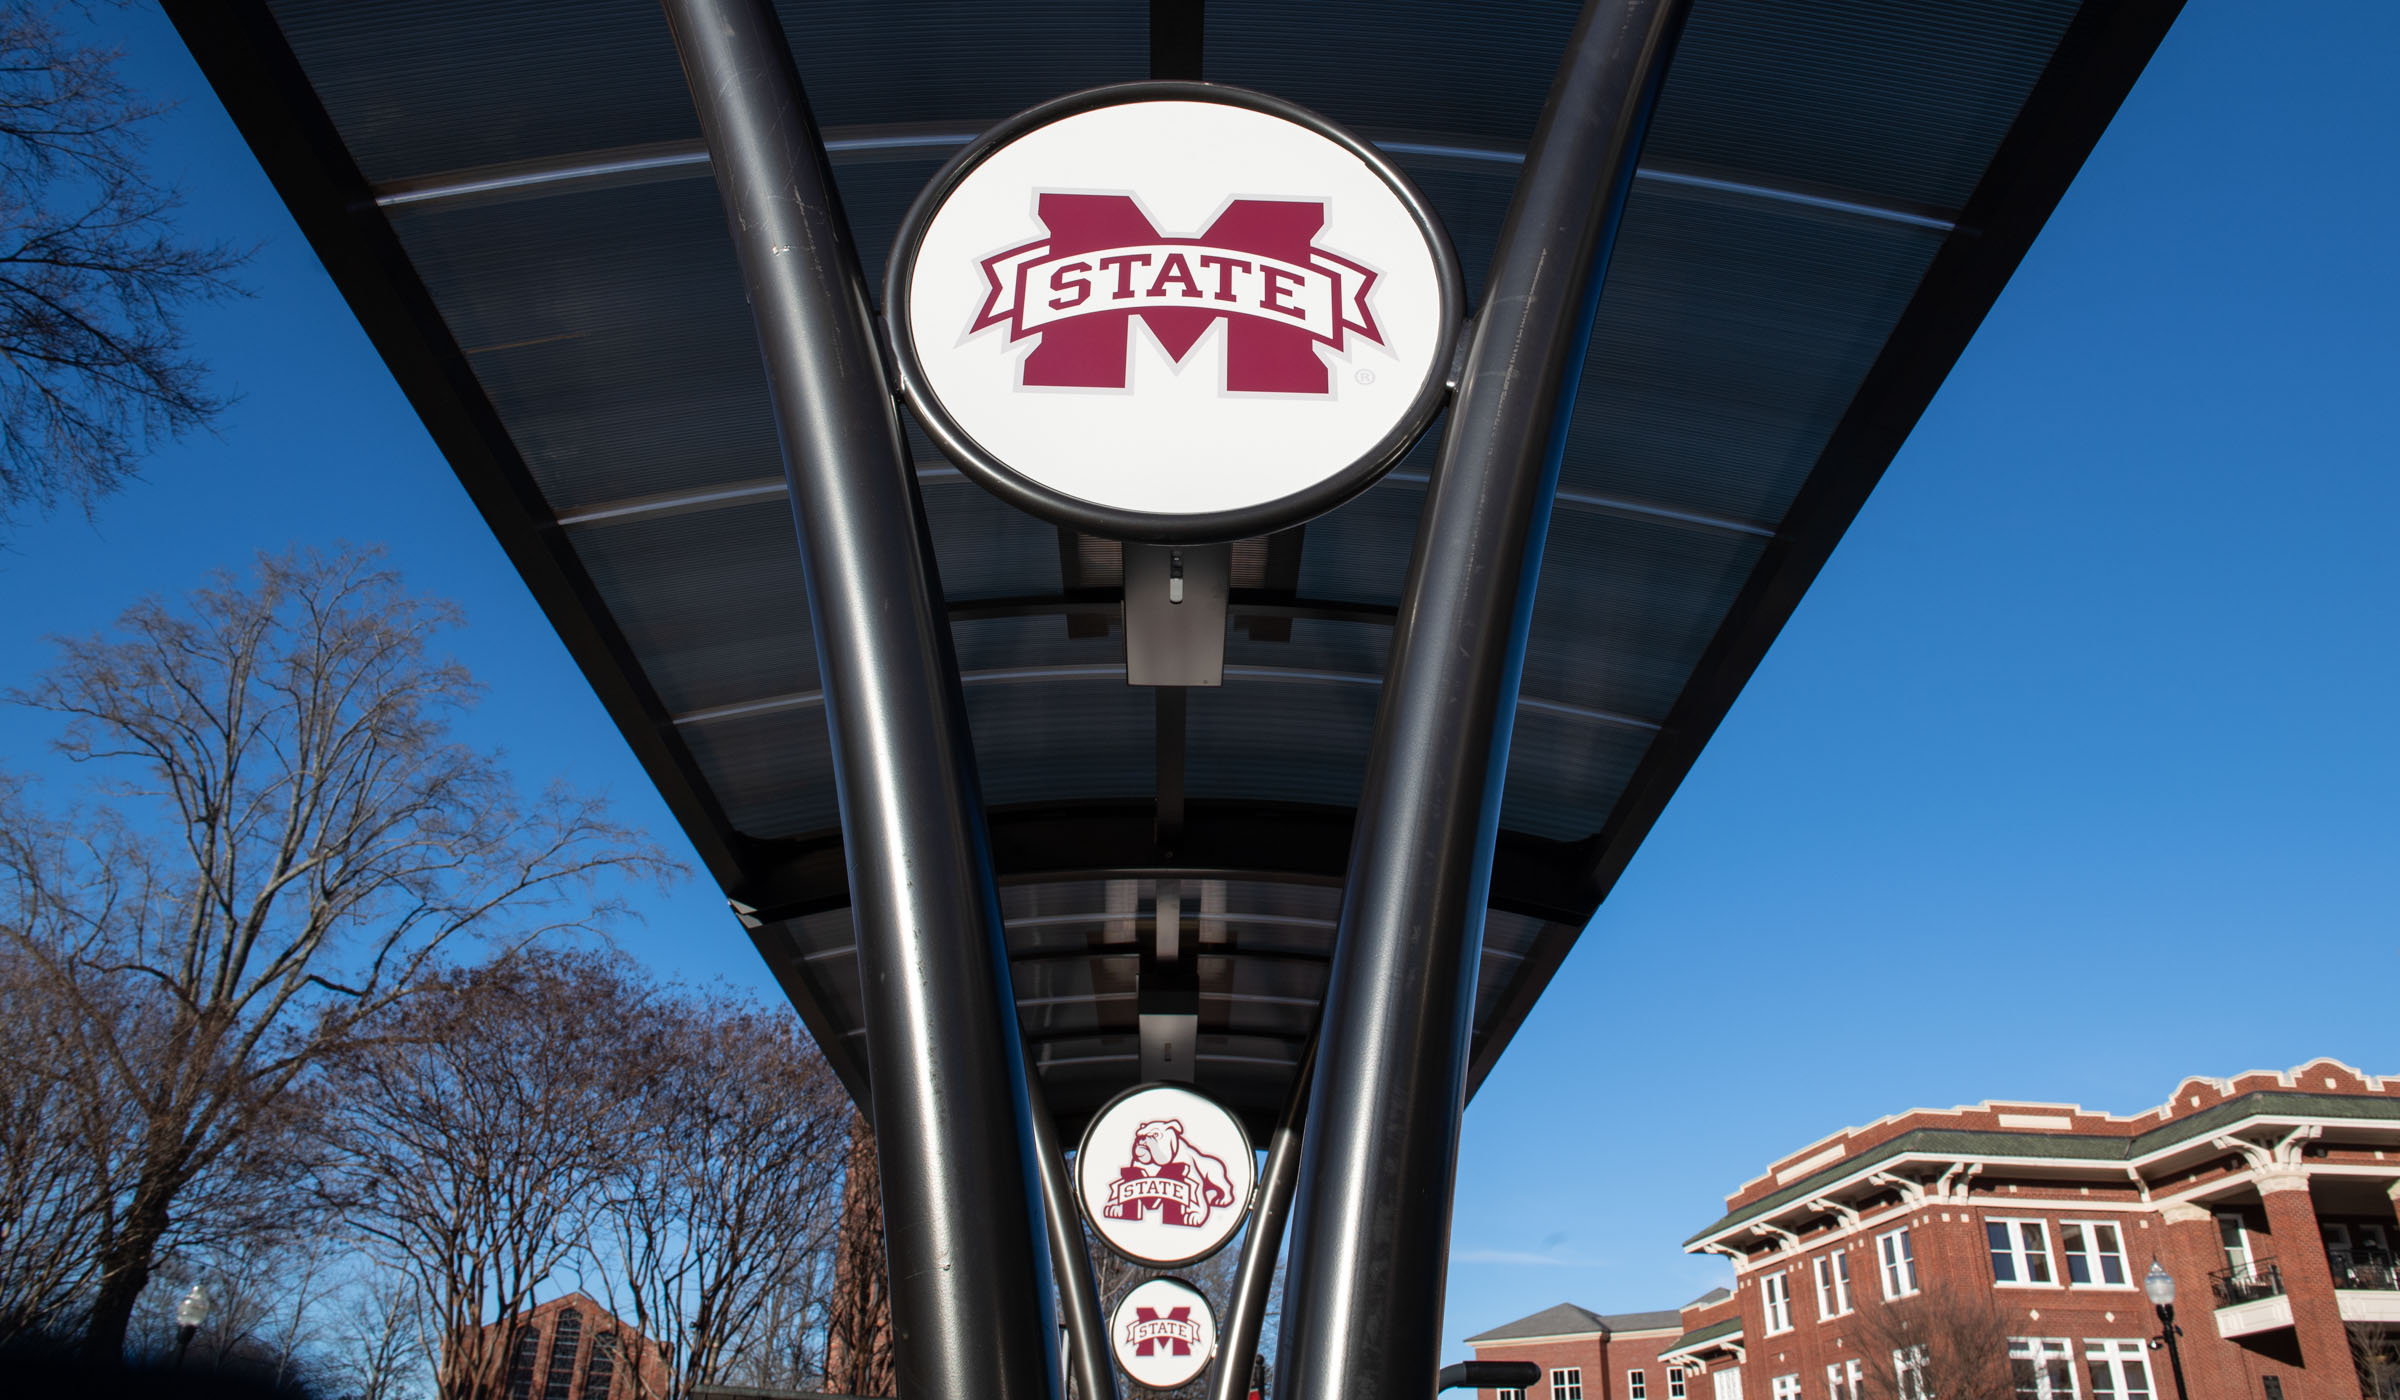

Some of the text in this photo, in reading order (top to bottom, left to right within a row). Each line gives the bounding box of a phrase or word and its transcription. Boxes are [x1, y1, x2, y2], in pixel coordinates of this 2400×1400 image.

[1023, 193, 1329, 393] M
[1049, 253, 1306, 320] STATE
[1123, 1180, 1184, 1199] STATE
[1136, 1307, 1191, 1356] M
[1139, 1321, 1188, 1338] STATE
